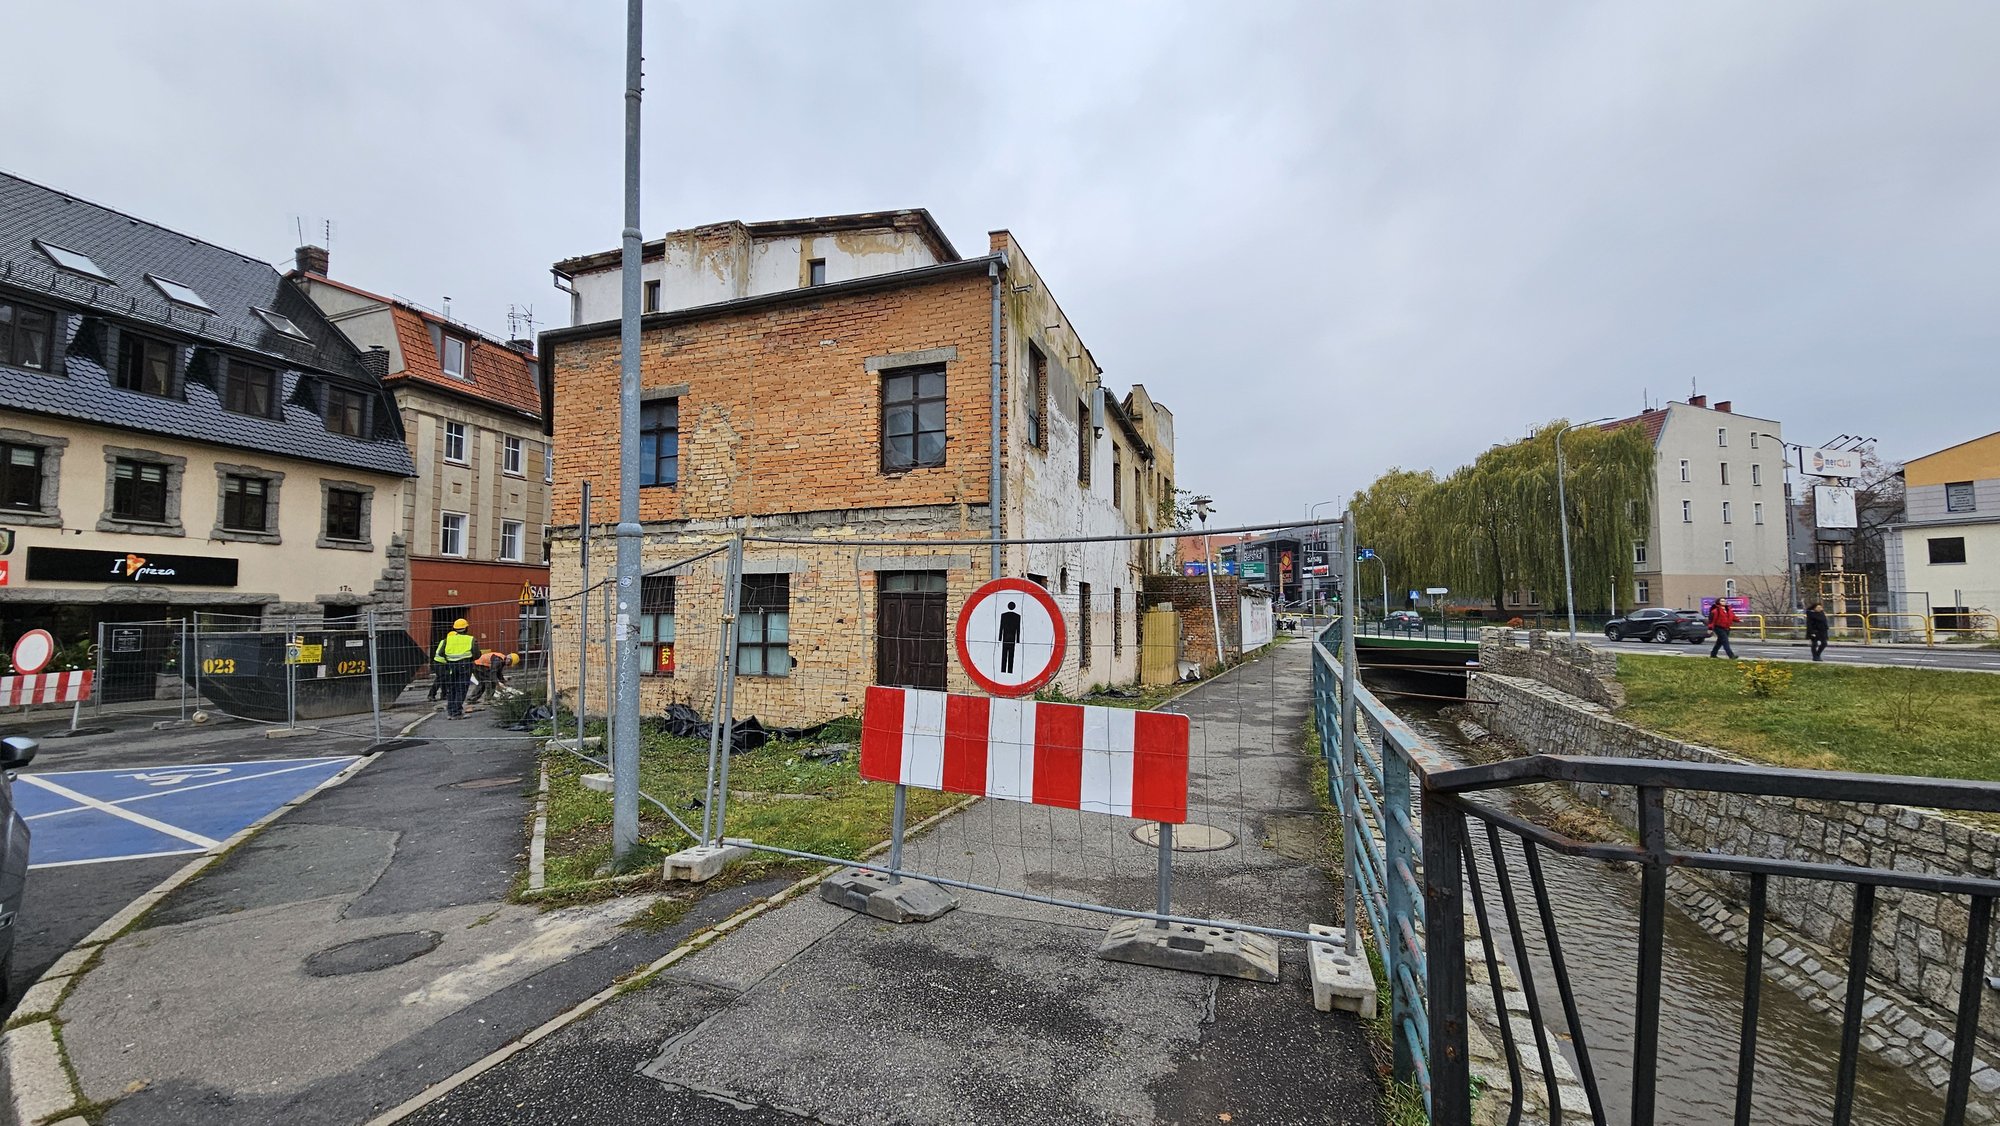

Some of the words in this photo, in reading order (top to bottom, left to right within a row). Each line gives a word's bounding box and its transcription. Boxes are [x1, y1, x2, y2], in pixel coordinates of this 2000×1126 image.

[110, 559, 125, 574] I
[135, 563, 176, 581] pizza
[203, 658, 236, 674] 023
[337, 660, 366, 675] 023
